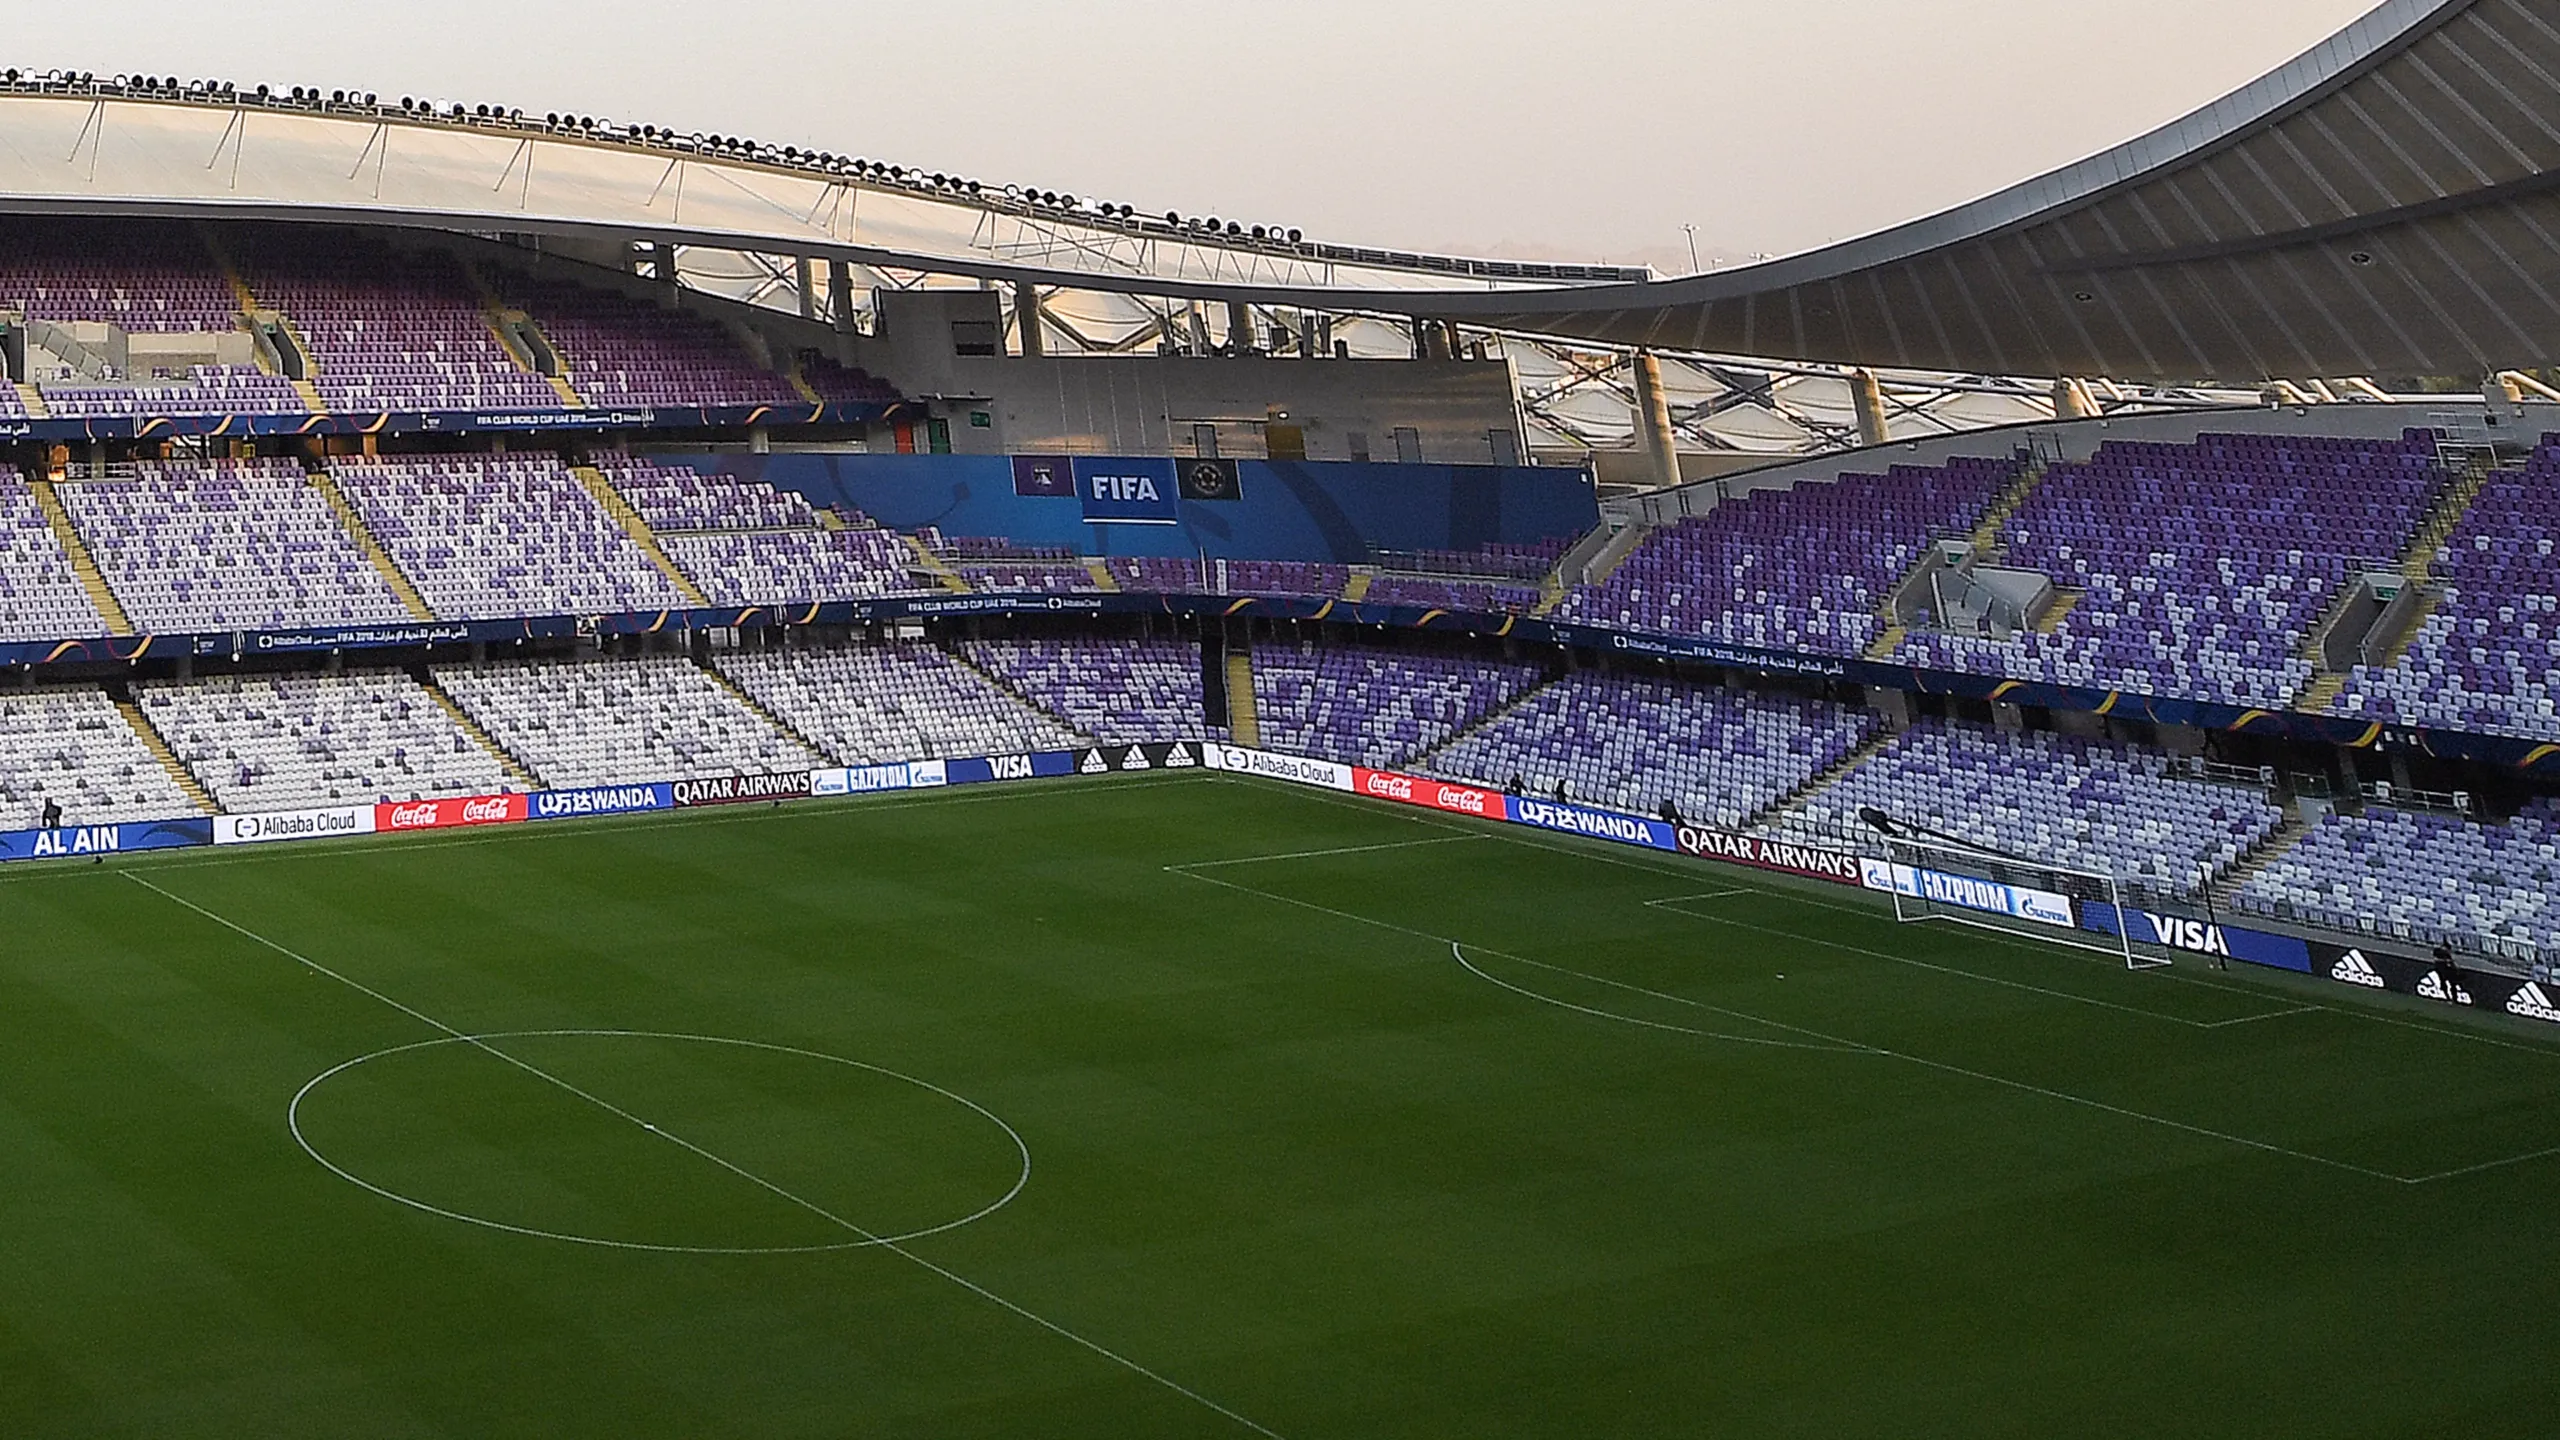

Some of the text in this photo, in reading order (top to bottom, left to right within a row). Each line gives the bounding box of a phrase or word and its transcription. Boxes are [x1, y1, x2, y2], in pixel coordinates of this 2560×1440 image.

[1091, 476, 1159, 501] FIFA
[850, 764, 908, 791] GAZPROM
[986, 754, 1033, 779] VISA
[1252, 754, 1335, 784] Alibaba Cloud
[591, 787, 657, 810] WANDA
[673, 771, 810, 805] QATAR AIRWAYS
[263, 810, 356, 836] Alibaba Cloud
[1575, 811, 1654, 844] WANDA
[33, 826, 119, 856] AL AIN
[1678, 827, 1858, 879] QATAR AIRWAYS
[1921, 869, 2010, 913] GAZPROM
[2142, 911, 2231, 956] VISA
[2331, 968, 2384, 988] adidas
